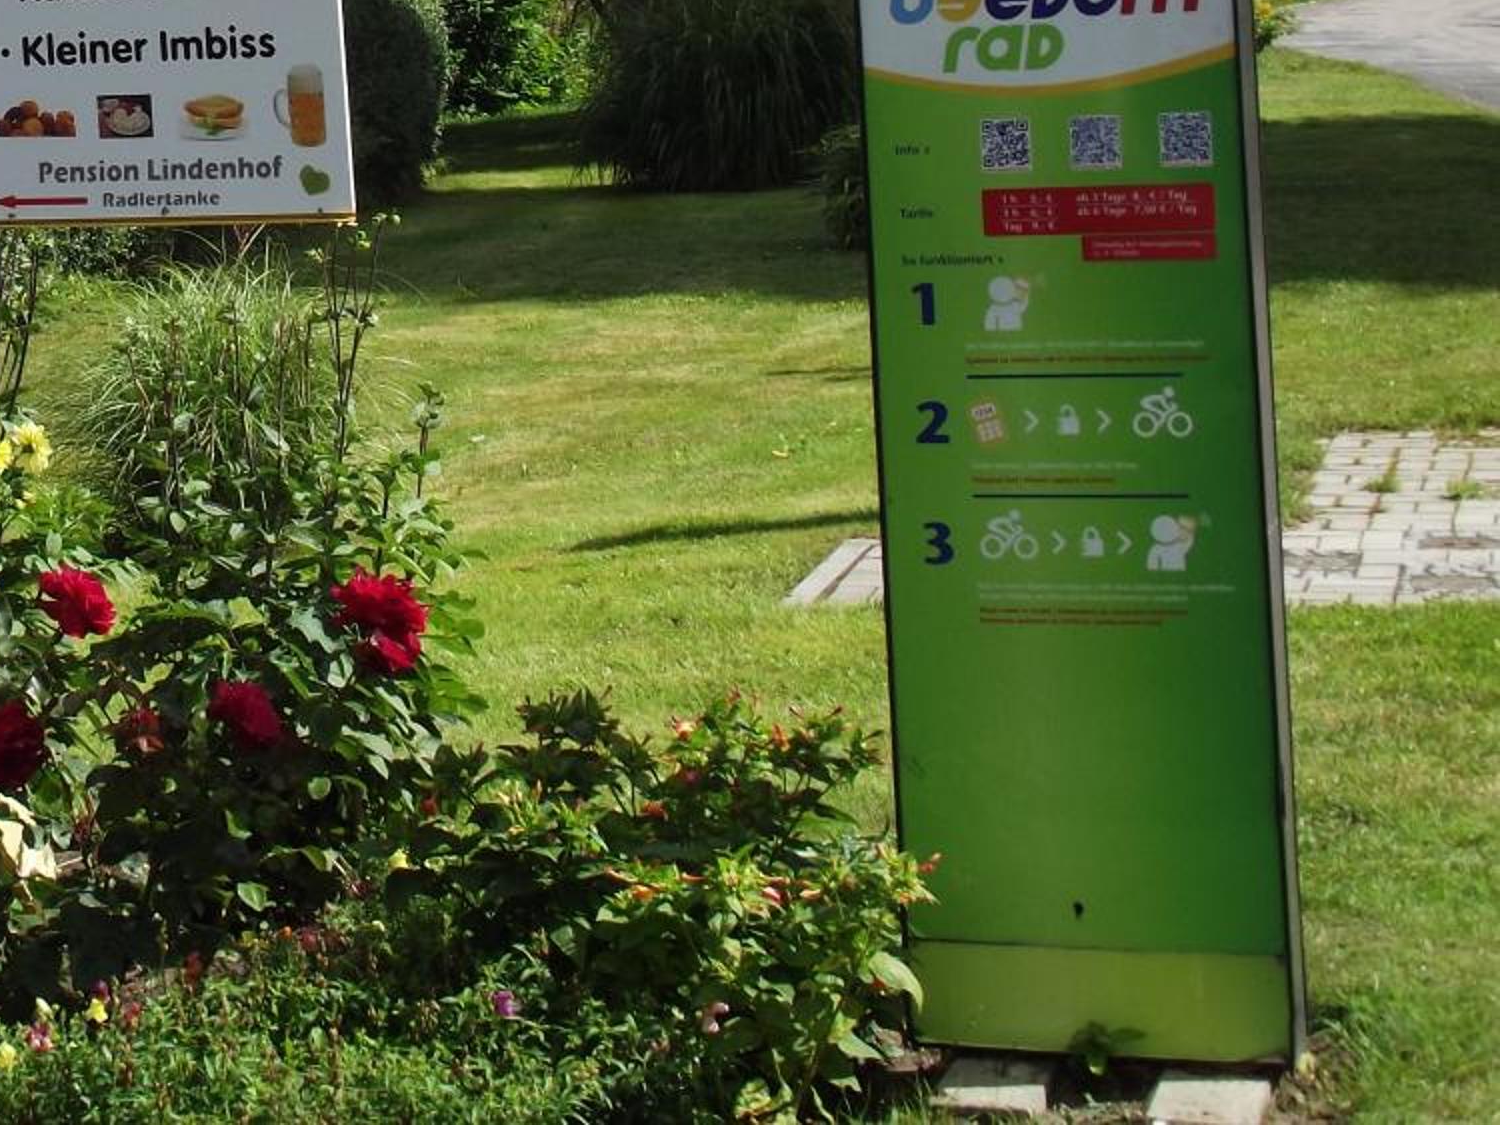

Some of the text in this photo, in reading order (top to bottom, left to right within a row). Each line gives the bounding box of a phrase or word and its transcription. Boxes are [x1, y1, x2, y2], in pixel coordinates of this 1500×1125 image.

[22, 25, 276, 66] Kleiner Imbiss
[38, 155, 283, 184] Pension Lindenhof
[102, 191, 221, 208] Radlertanke
[911, 282, 936, 326] 1
[916, 400, 950, 444] 2
[922, 521, 955, 566] 3
